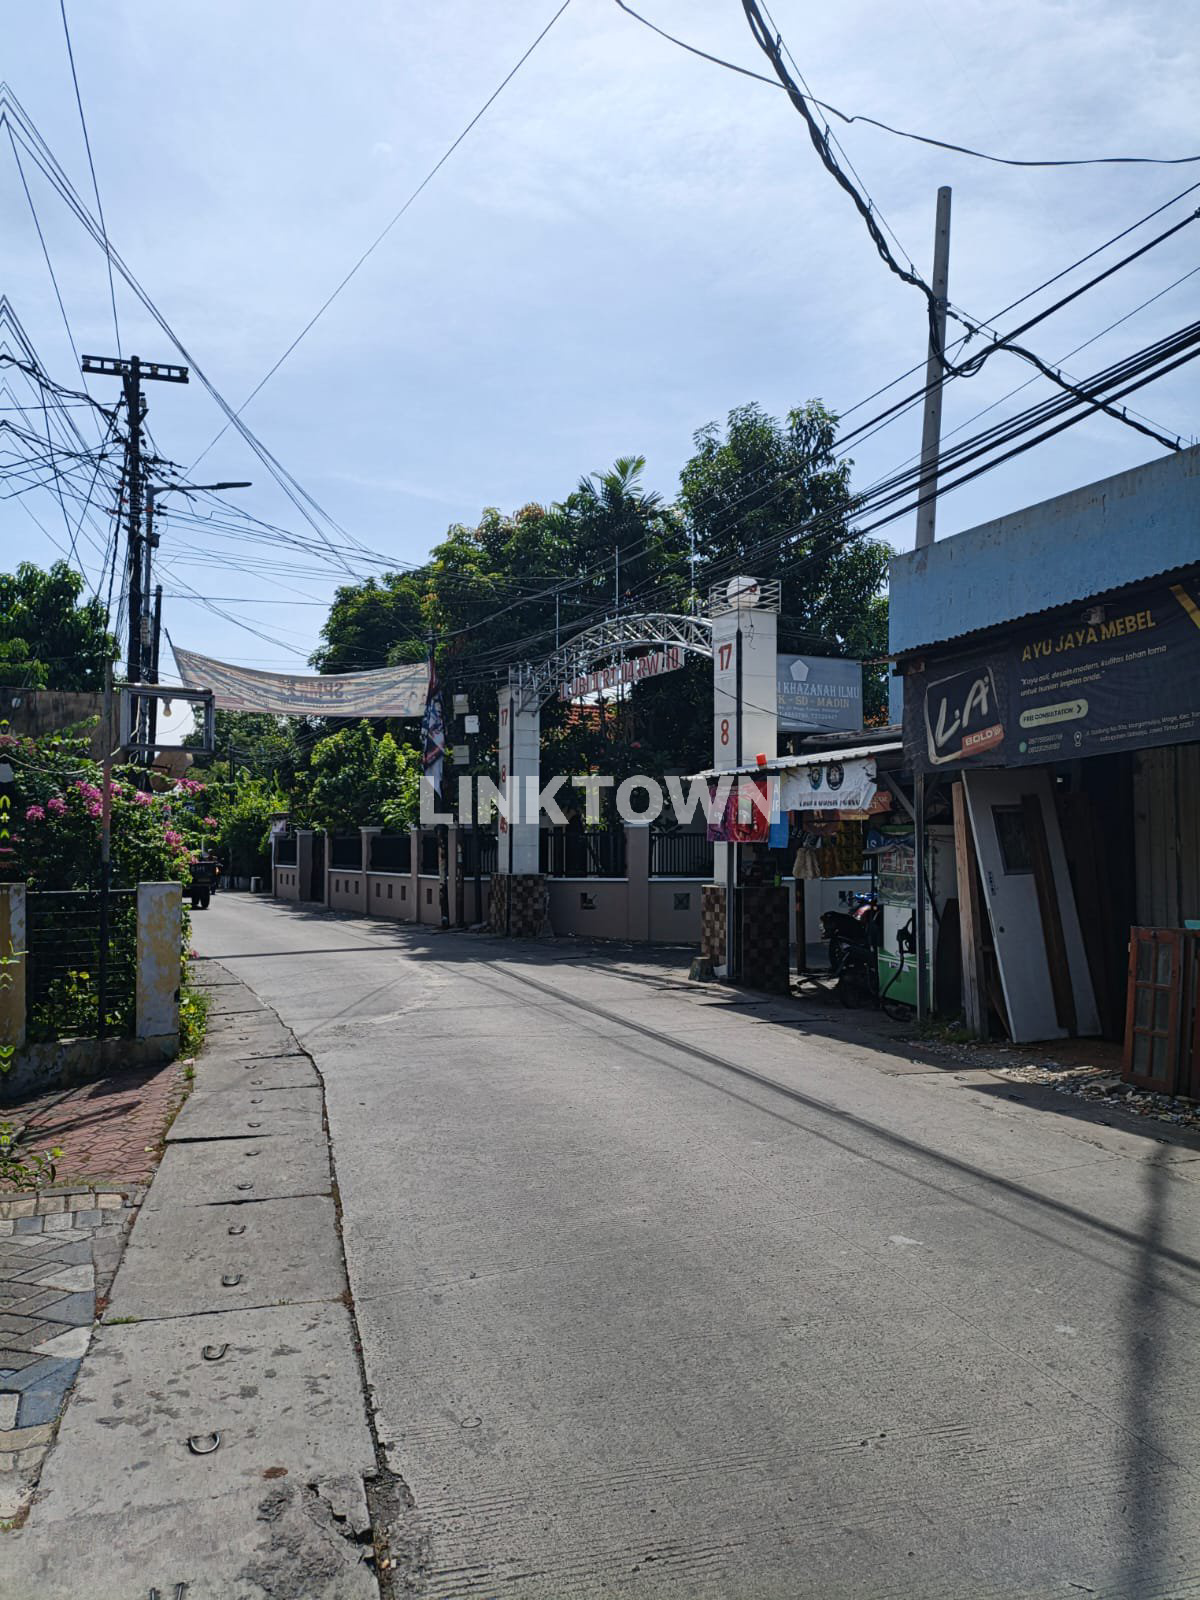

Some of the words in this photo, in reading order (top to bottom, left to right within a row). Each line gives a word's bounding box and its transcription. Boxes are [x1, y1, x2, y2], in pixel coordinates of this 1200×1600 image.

[1022, 639, 1053, 661] AYU
[1055, 627, 1099, 652] JAYA
[1100, 610, 1156, 640] MEBEL
[718, 643, 732, 671] 17
[1125, 650, 1147, 662] tahan
[1147, 644, 1167, 656] lama
[784, 681, 837, 698] KHAZANAH
[838, 685, 860, 699] ILMU
[794, 695, 810, 707] SD
[815, 696, 849, 709] MADIN
[501, 708, 508, 727] 17
[721, 719, 729, 745] 8
